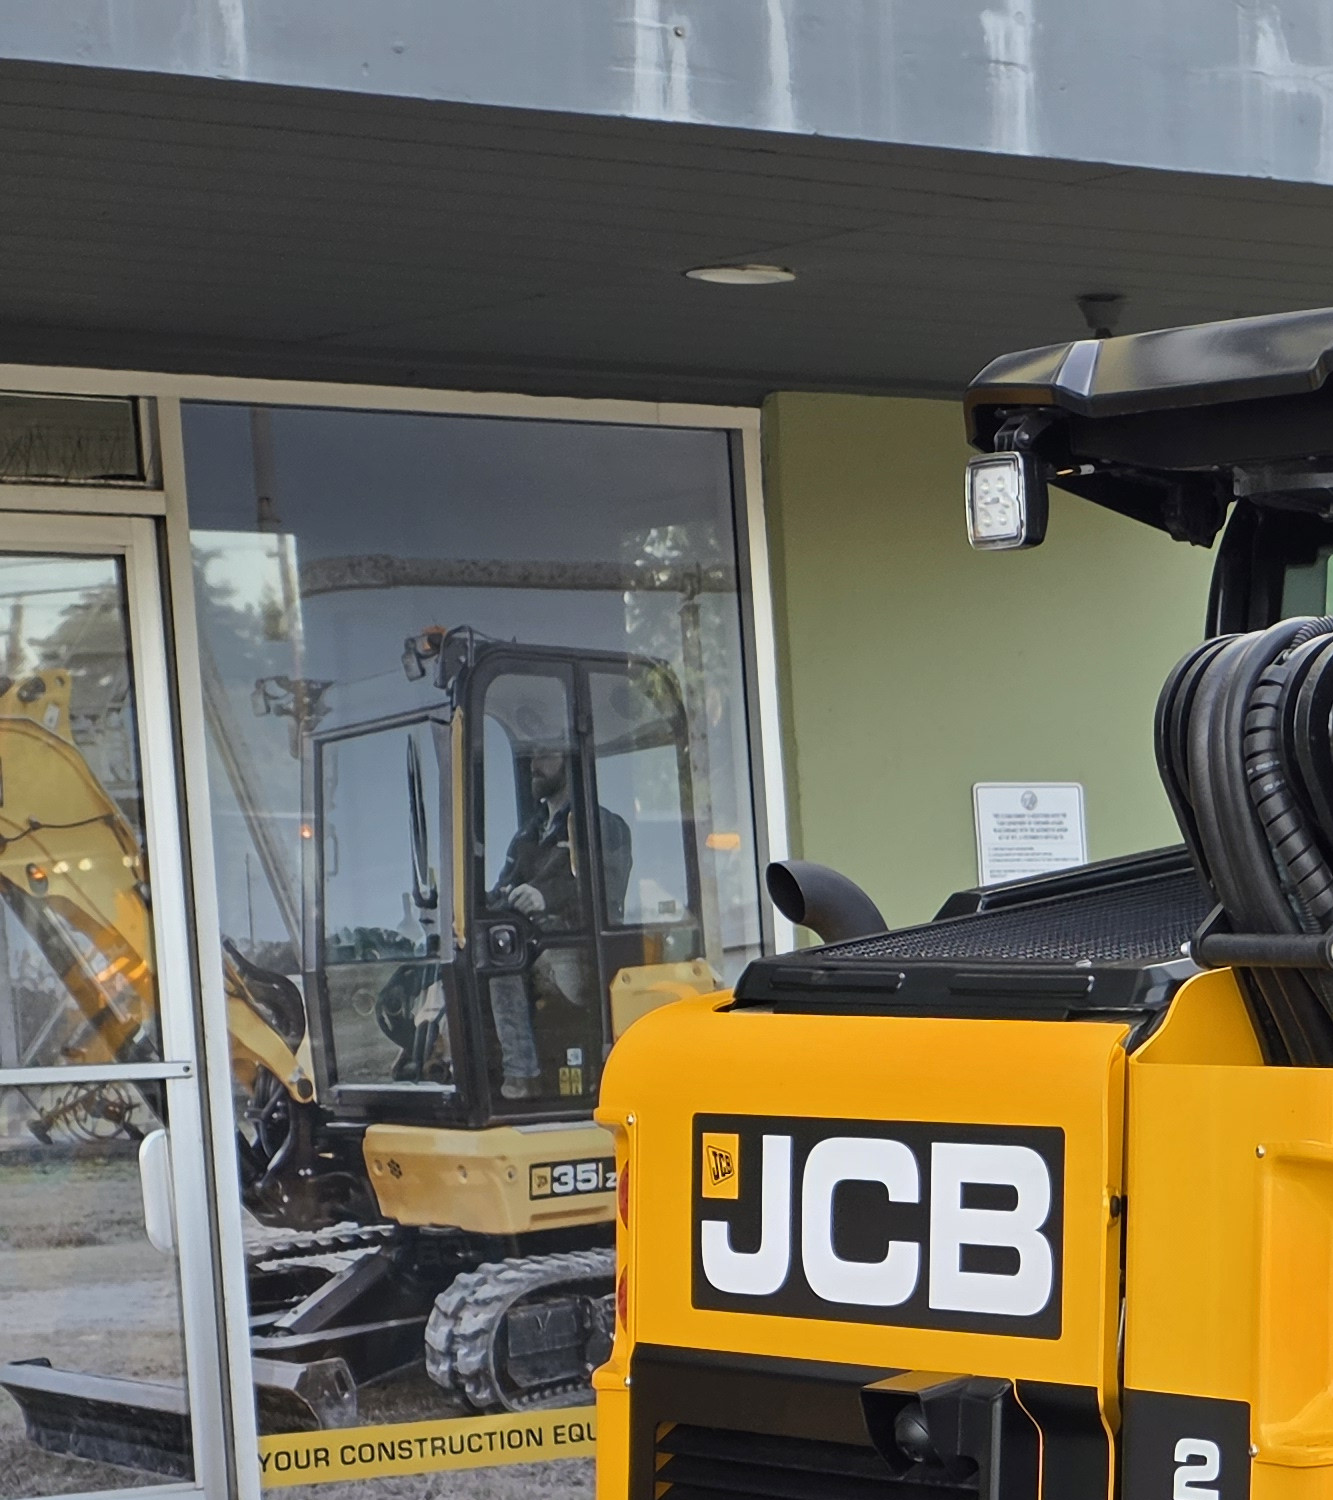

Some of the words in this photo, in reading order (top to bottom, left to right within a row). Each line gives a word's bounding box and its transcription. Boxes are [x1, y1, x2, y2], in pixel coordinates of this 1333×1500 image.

[712, 1150, 733, 1180] JCB
[702, 1135, 1052, 1316] JCB
[258, 1447, 330, 1473] YOUR
[340, 1427, 543, 1465] CONSTRUCTION
